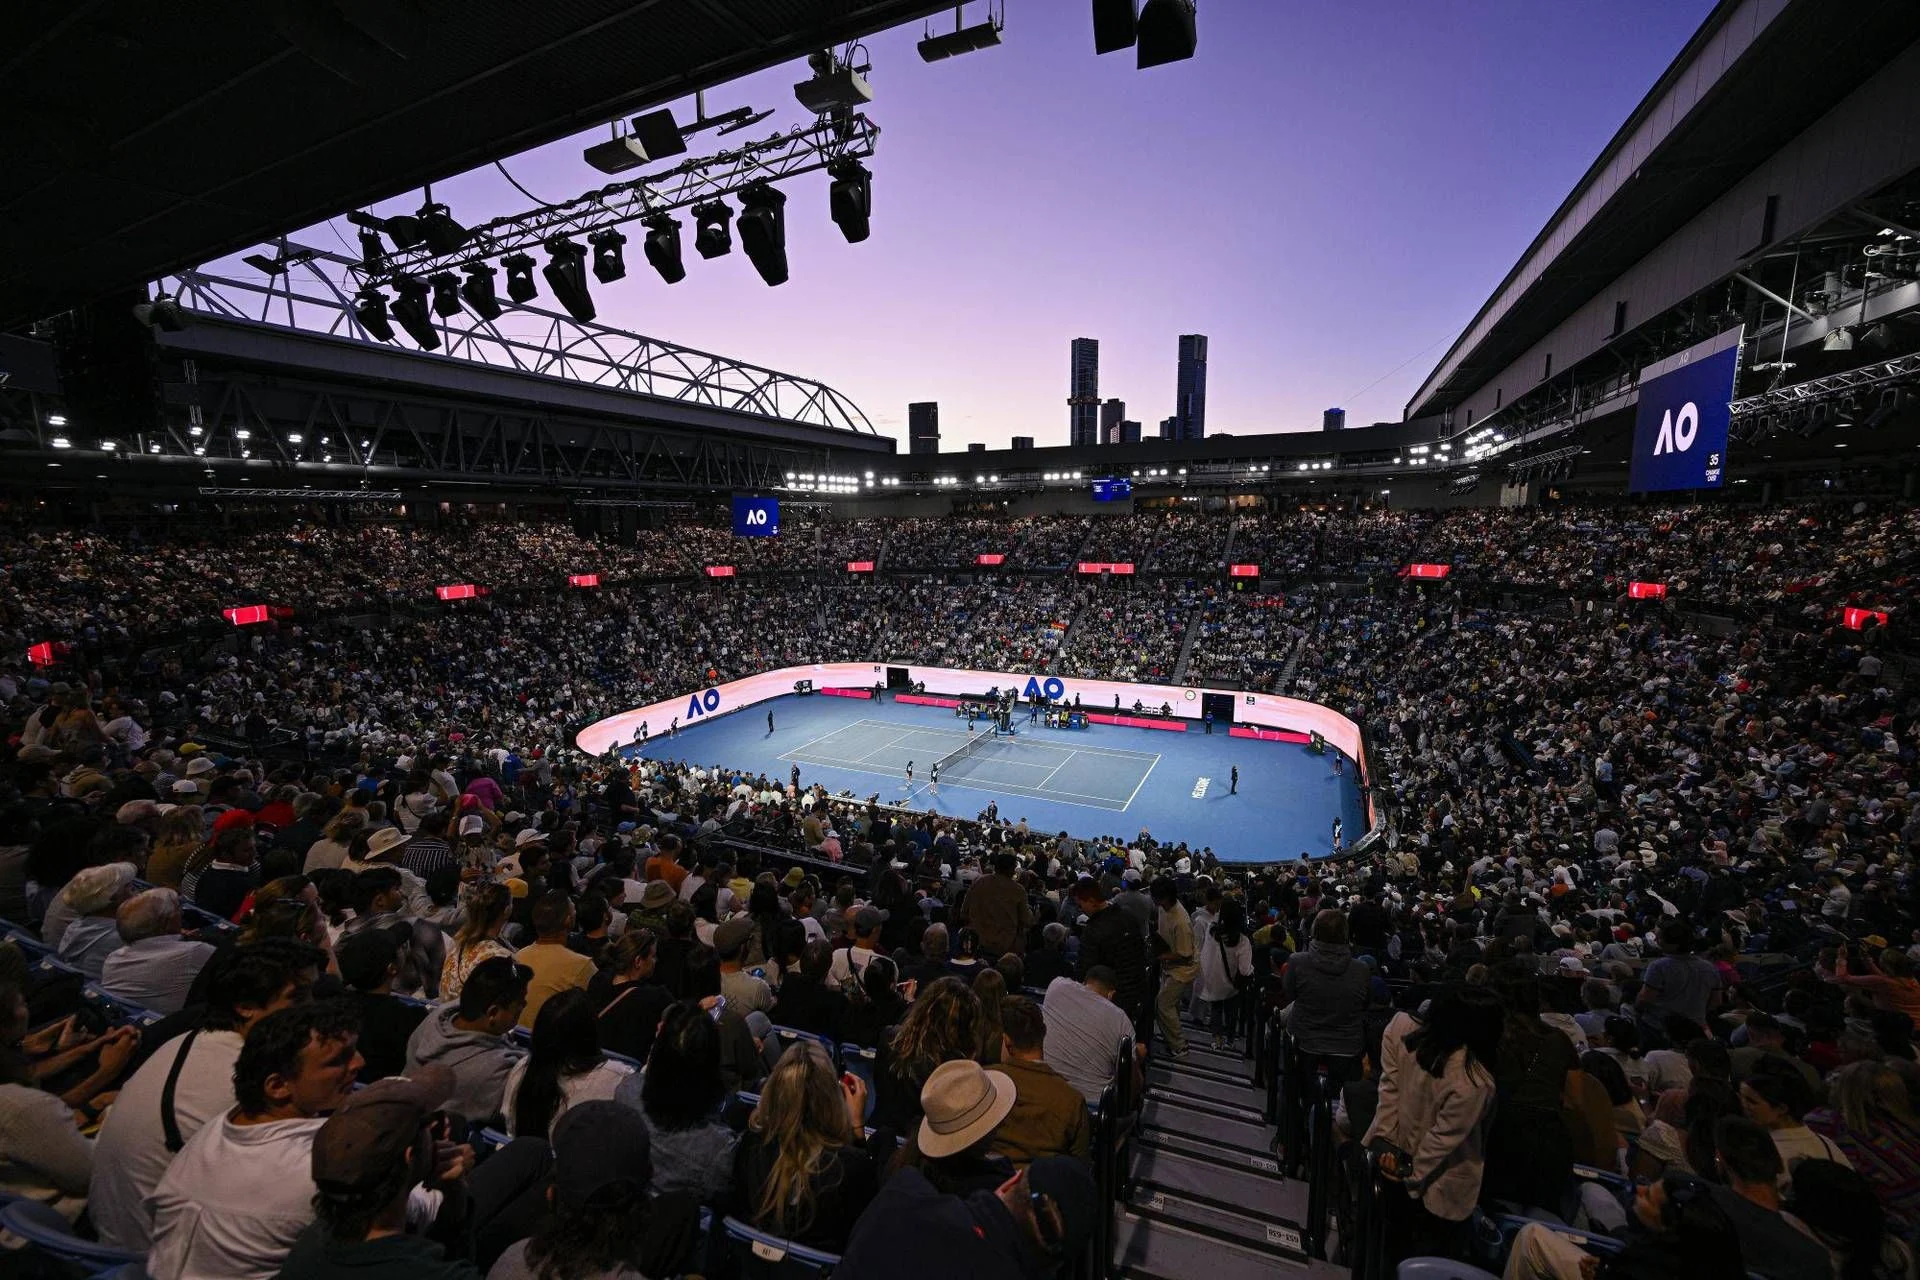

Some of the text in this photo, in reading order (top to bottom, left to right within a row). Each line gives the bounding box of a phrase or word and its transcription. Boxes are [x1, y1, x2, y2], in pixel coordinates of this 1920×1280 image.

[1653, 402, 1698, 455] AO
[1709, 453, 1719, 465] 35
[746, 509, 767, 525] AO
[1022, 677, 1064, 700] AO
[687, 688, 720, 719] AO
